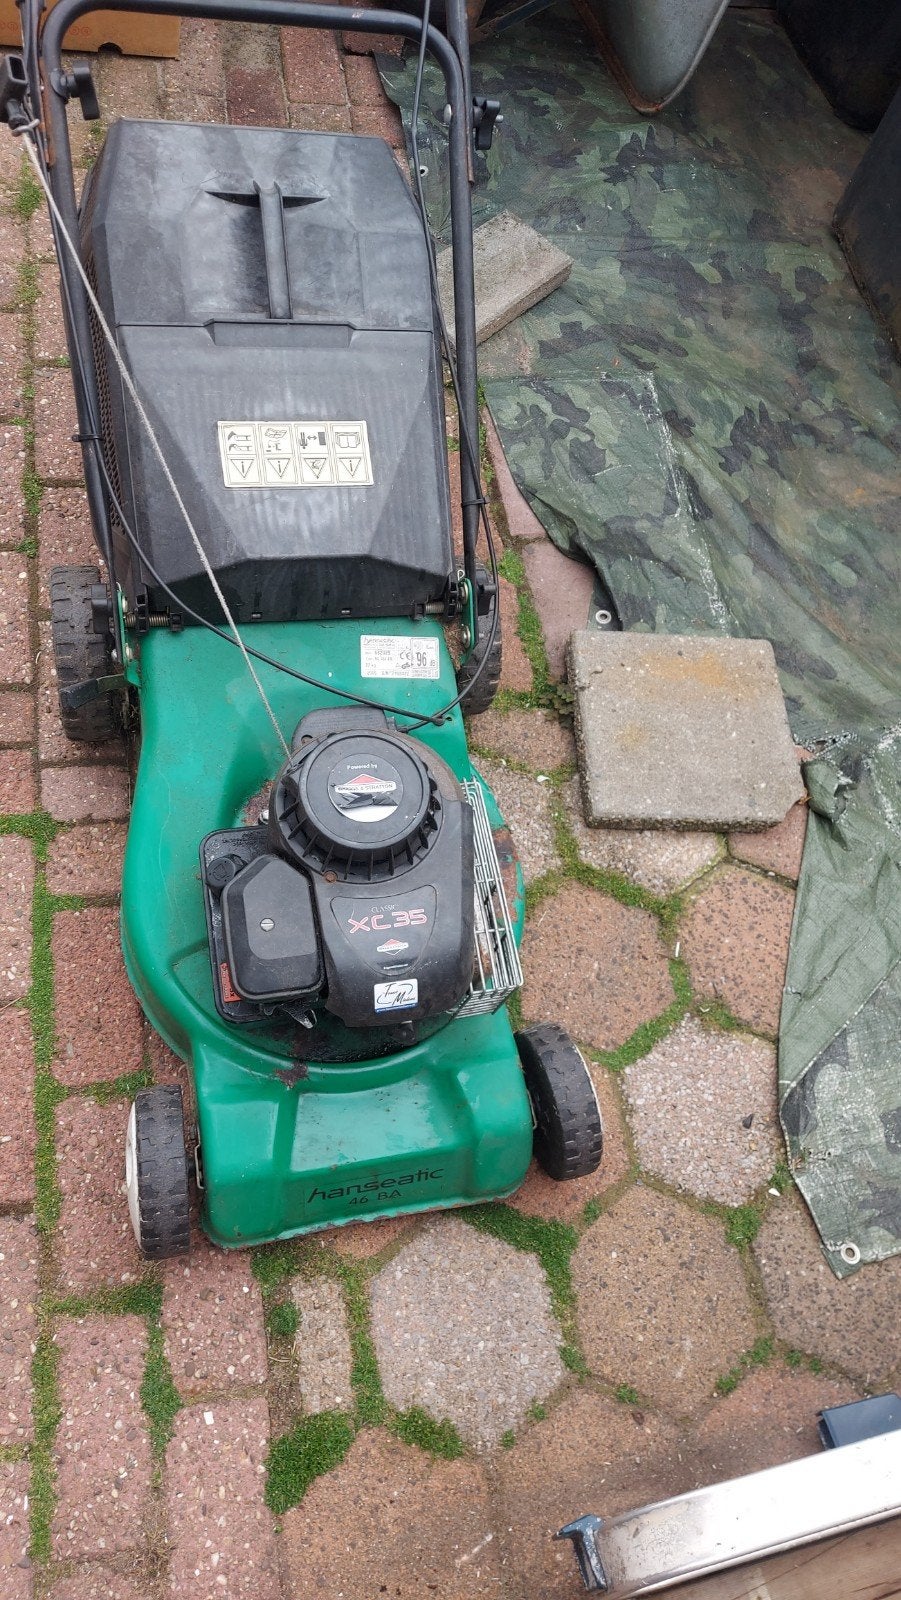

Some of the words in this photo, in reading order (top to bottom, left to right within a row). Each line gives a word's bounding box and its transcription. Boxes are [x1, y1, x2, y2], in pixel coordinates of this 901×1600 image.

[416, 651, 427, 667] 96
[307, 1168, 444, 1204] hanseatic
[349, 1197, 369, 1205] 46
[377, 1189, 402, 1201] BA
